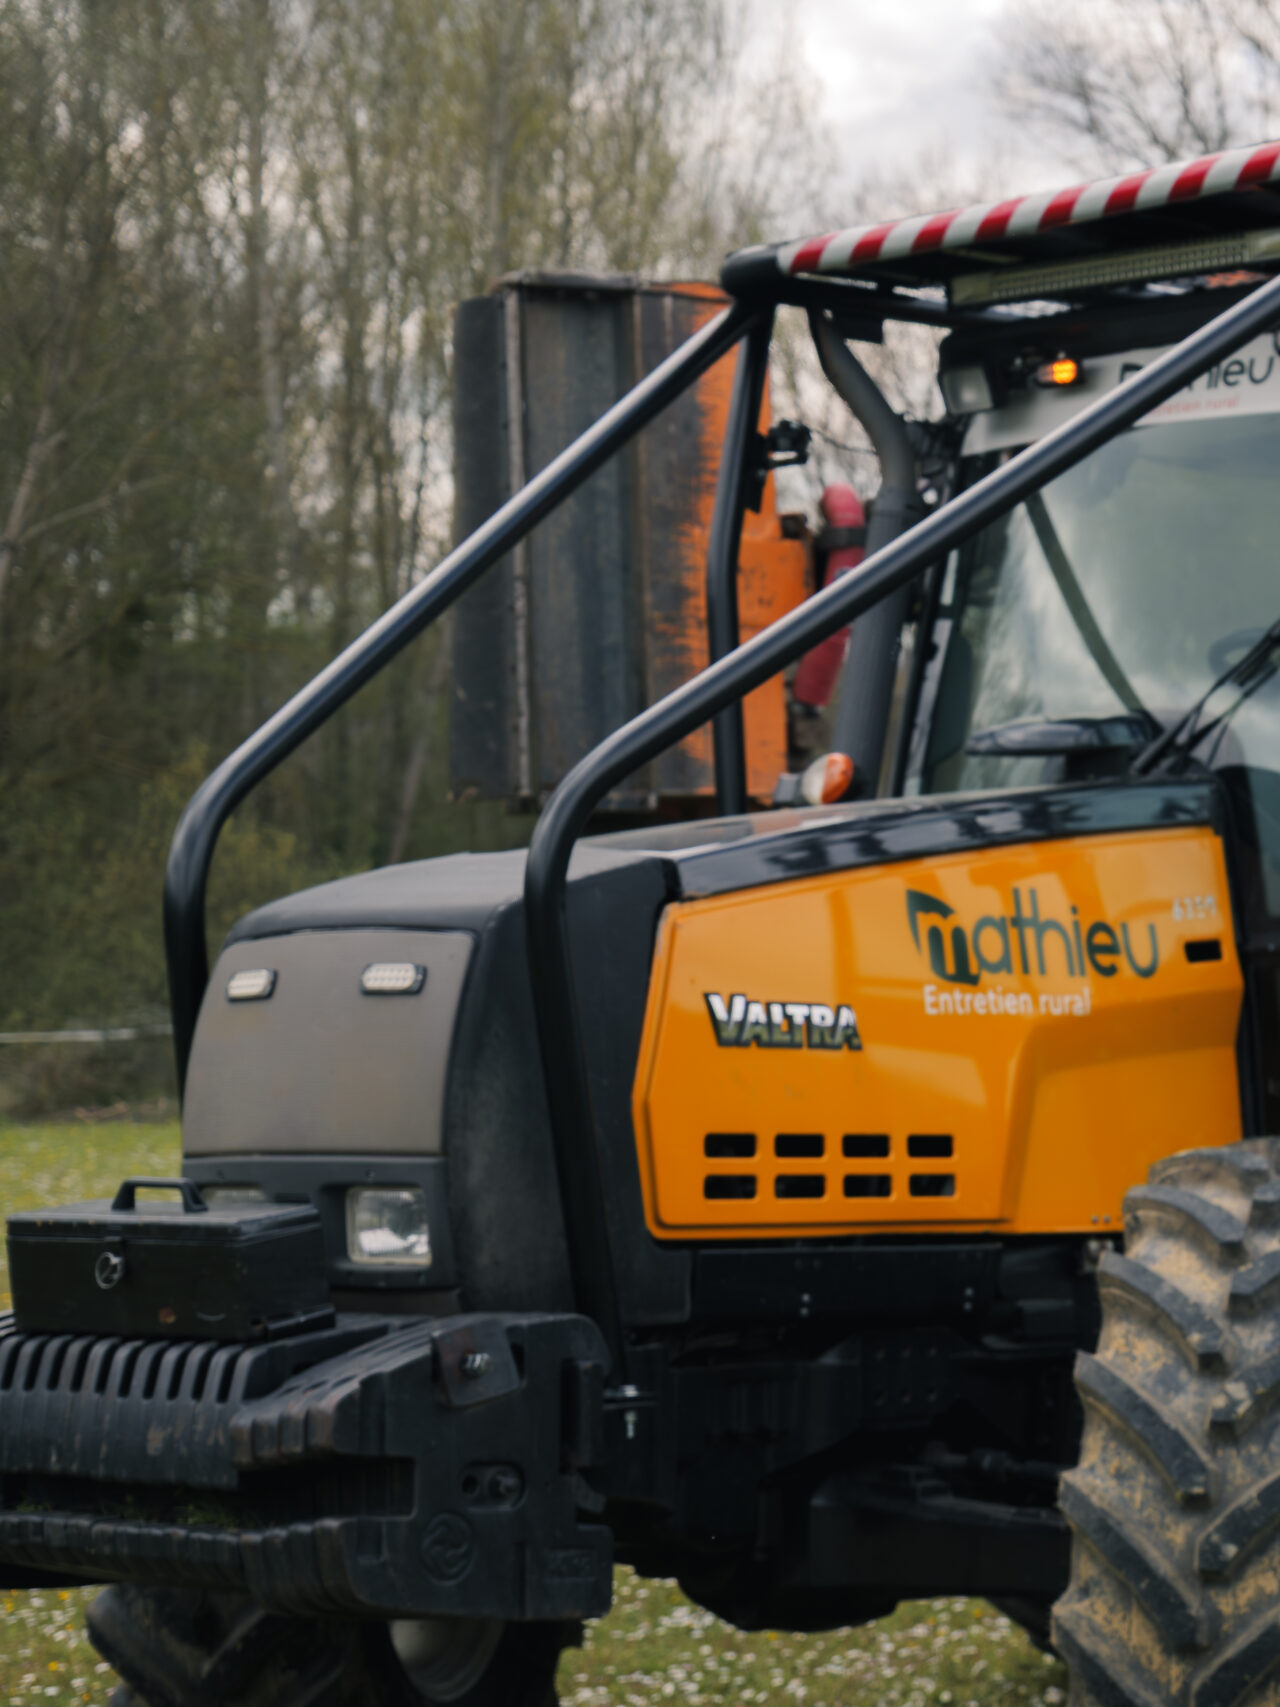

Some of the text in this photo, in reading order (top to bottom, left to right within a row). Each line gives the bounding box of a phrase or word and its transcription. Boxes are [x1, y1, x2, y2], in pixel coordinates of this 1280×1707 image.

[703, 992, 863, 1052] VALTRA
[923, 984, 1091, 1016] Entretien rural
